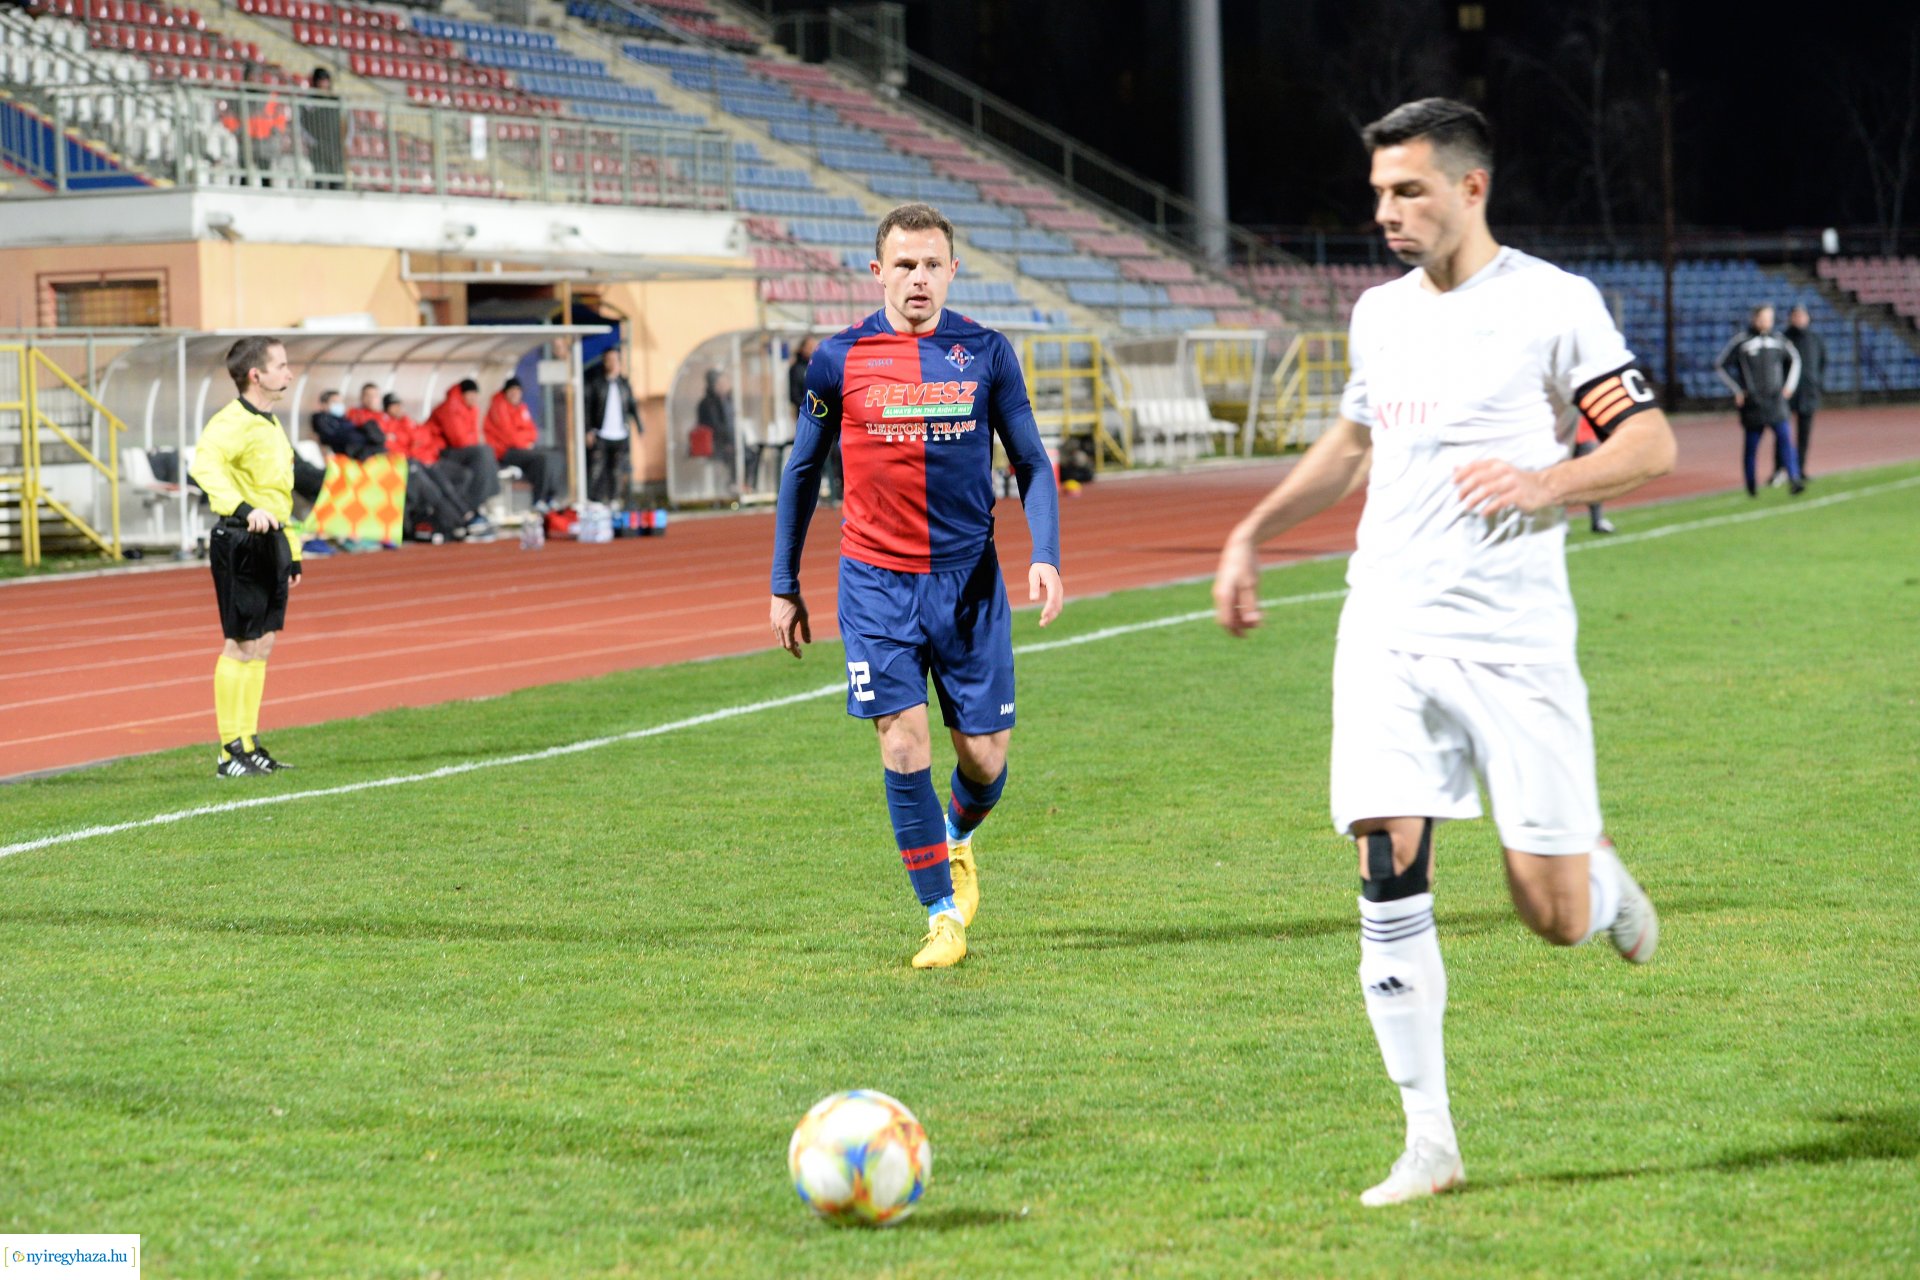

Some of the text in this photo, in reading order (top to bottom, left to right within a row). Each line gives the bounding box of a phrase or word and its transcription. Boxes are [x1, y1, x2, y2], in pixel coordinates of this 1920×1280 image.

[865, 381, 978, 407] REVESZ
[1621, 369, 1654, 402] C
[930, 419, 977, 434] TRANS
